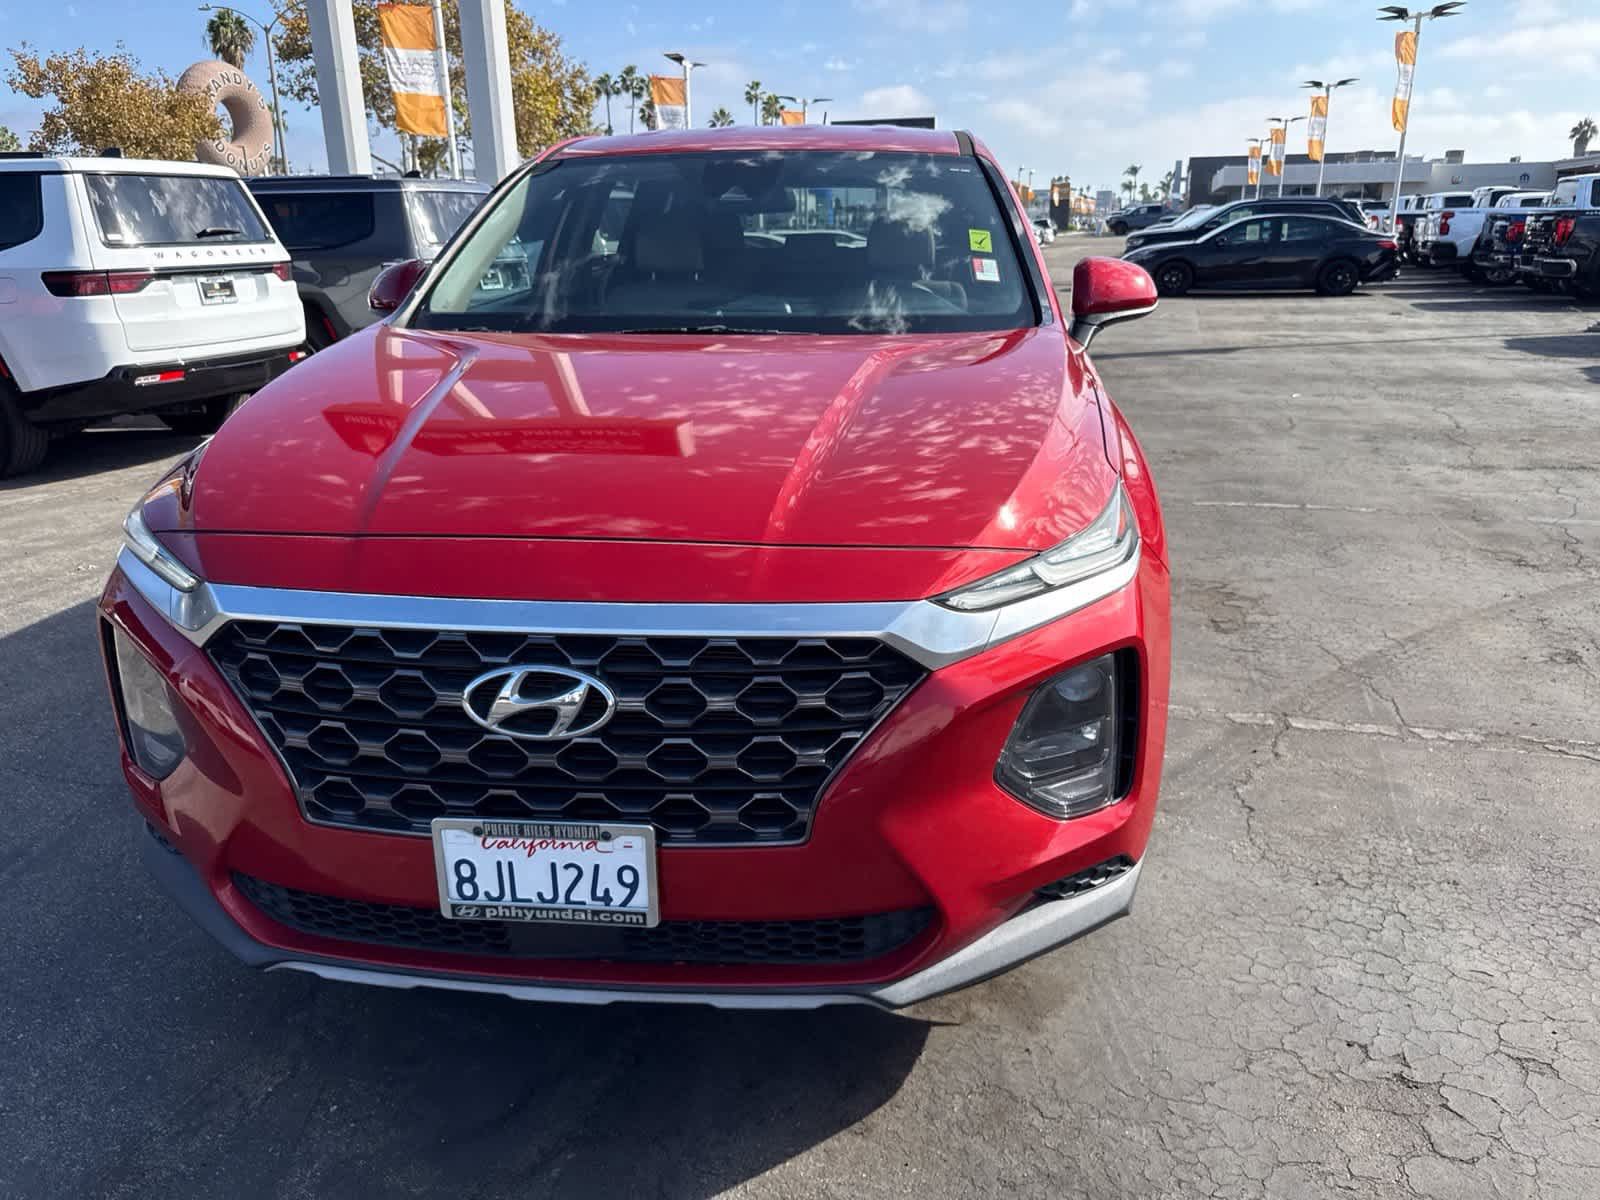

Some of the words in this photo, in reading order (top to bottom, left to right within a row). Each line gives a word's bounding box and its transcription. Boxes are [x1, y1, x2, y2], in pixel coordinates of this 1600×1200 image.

[214, 140, 271, 171] DONUTS
[153, 247, 267, 260] WAGONEER
[484, 822, 520, 837] PUENTE
[523, 824, 551, 838] HILLS
[554, 825, 599, 840] HYUNDAI
[480, 836, 613, 858] California
[453, 858, 640, 908] 8JLJ249
[484, 906, 644, 924] phhyundai.com
